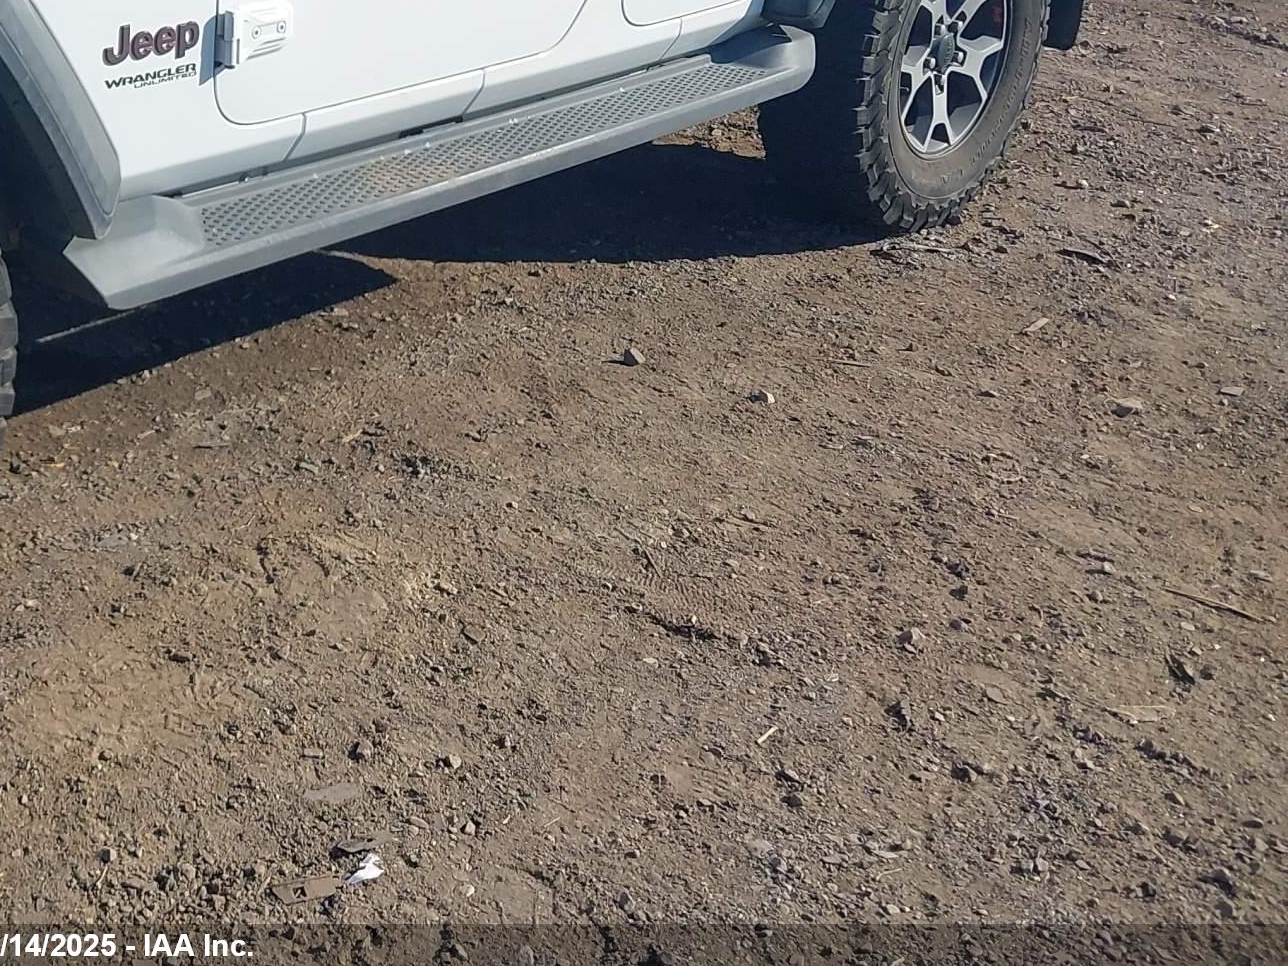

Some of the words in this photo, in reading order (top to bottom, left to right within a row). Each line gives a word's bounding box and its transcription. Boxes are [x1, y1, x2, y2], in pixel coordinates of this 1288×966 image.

[102, 20, 200, 66] Jeep
[104, 63, 197, 89] WRANGLER
[134, 71, 197, 89] UNLIMITED
